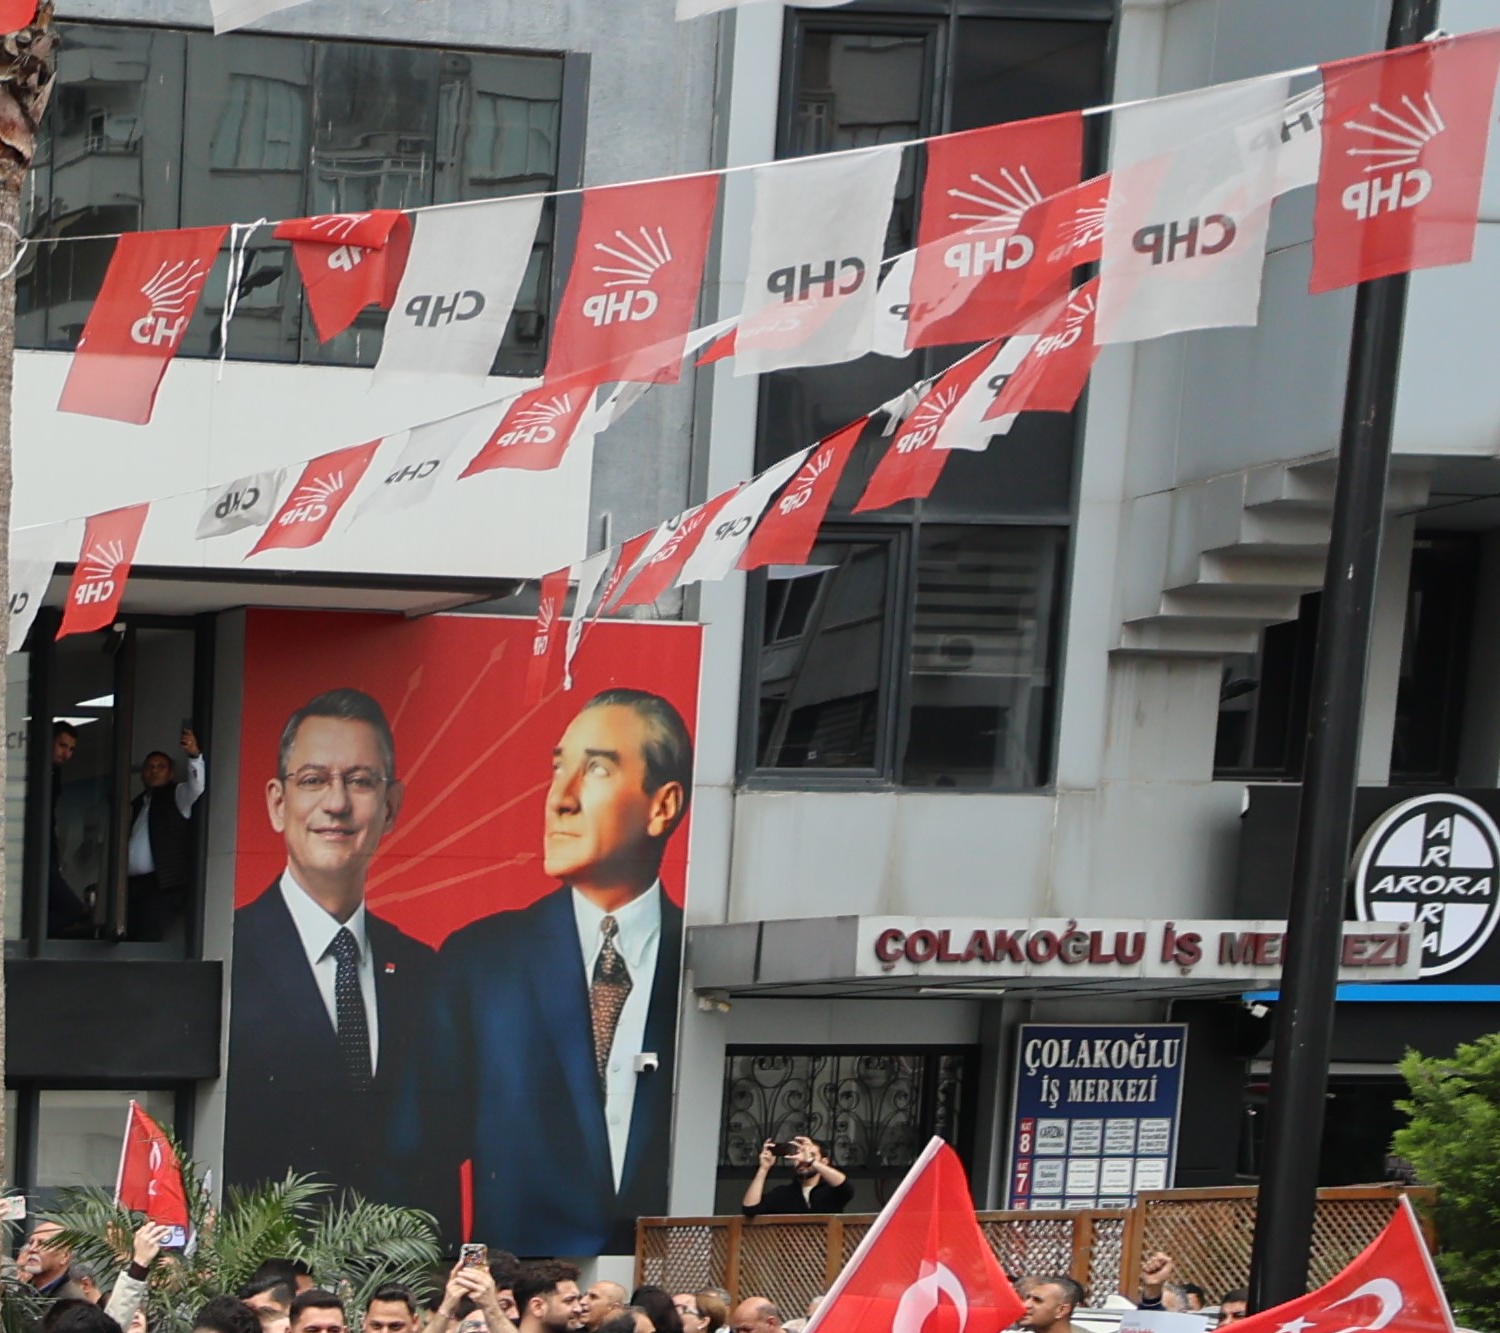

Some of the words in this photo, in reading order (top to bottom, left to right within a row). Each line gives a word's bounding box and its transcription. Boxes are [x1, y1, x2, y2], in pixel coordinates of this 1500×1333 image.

[1369, 874, 1492, 895] ARORA
[875, 919, 1147, 972] ÇOLAKOĞLU
[1162, 921, 1203, 975] İŞ
[1219, 921, 1412, 967] MEEZİ
[1024, 1031, 1181, 1077] ÇOLAKOĞLU
[1040, 1074, 1061, 1109] İŞ
[1067, 1074, 1158, 1103] MERKEZİ
[1019, 1134, 1030, 1153] 8
[1016, 1173, 1028, 1193] 7
